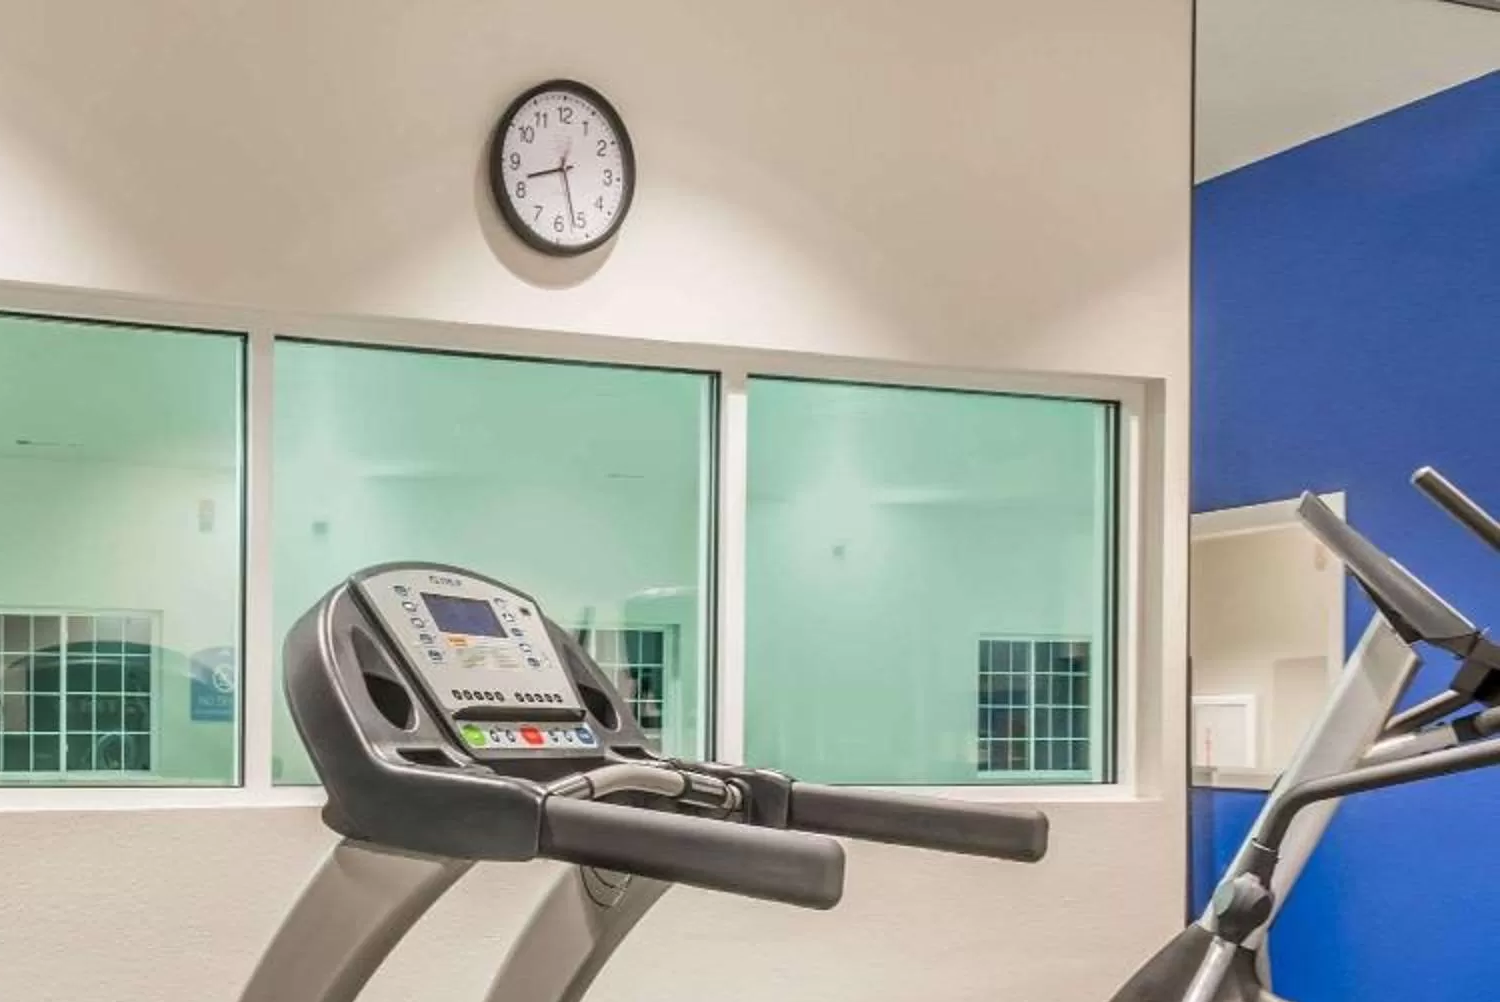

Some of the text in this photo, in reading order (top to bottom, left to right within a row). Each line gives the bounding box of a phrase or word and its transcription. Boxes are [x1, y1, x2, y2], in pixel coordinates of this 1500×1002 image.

[534, 111, 548, 128] 11
[558, 106, 573, 124] 12
[518, 125, 535, 143] 10
[582, 120, 589, 136] 1
[596, 139, 607, 157] 2
[509, 152, 521, 170] 9
[603, 169, 613, 187] 3
[515, 181, 526, 199] 8
[594, 195, 604, 211] 4
[533, 205, 543, 221] 7
[576, 211, 587, 229] 5
[553, 215, 565, 232] 6
